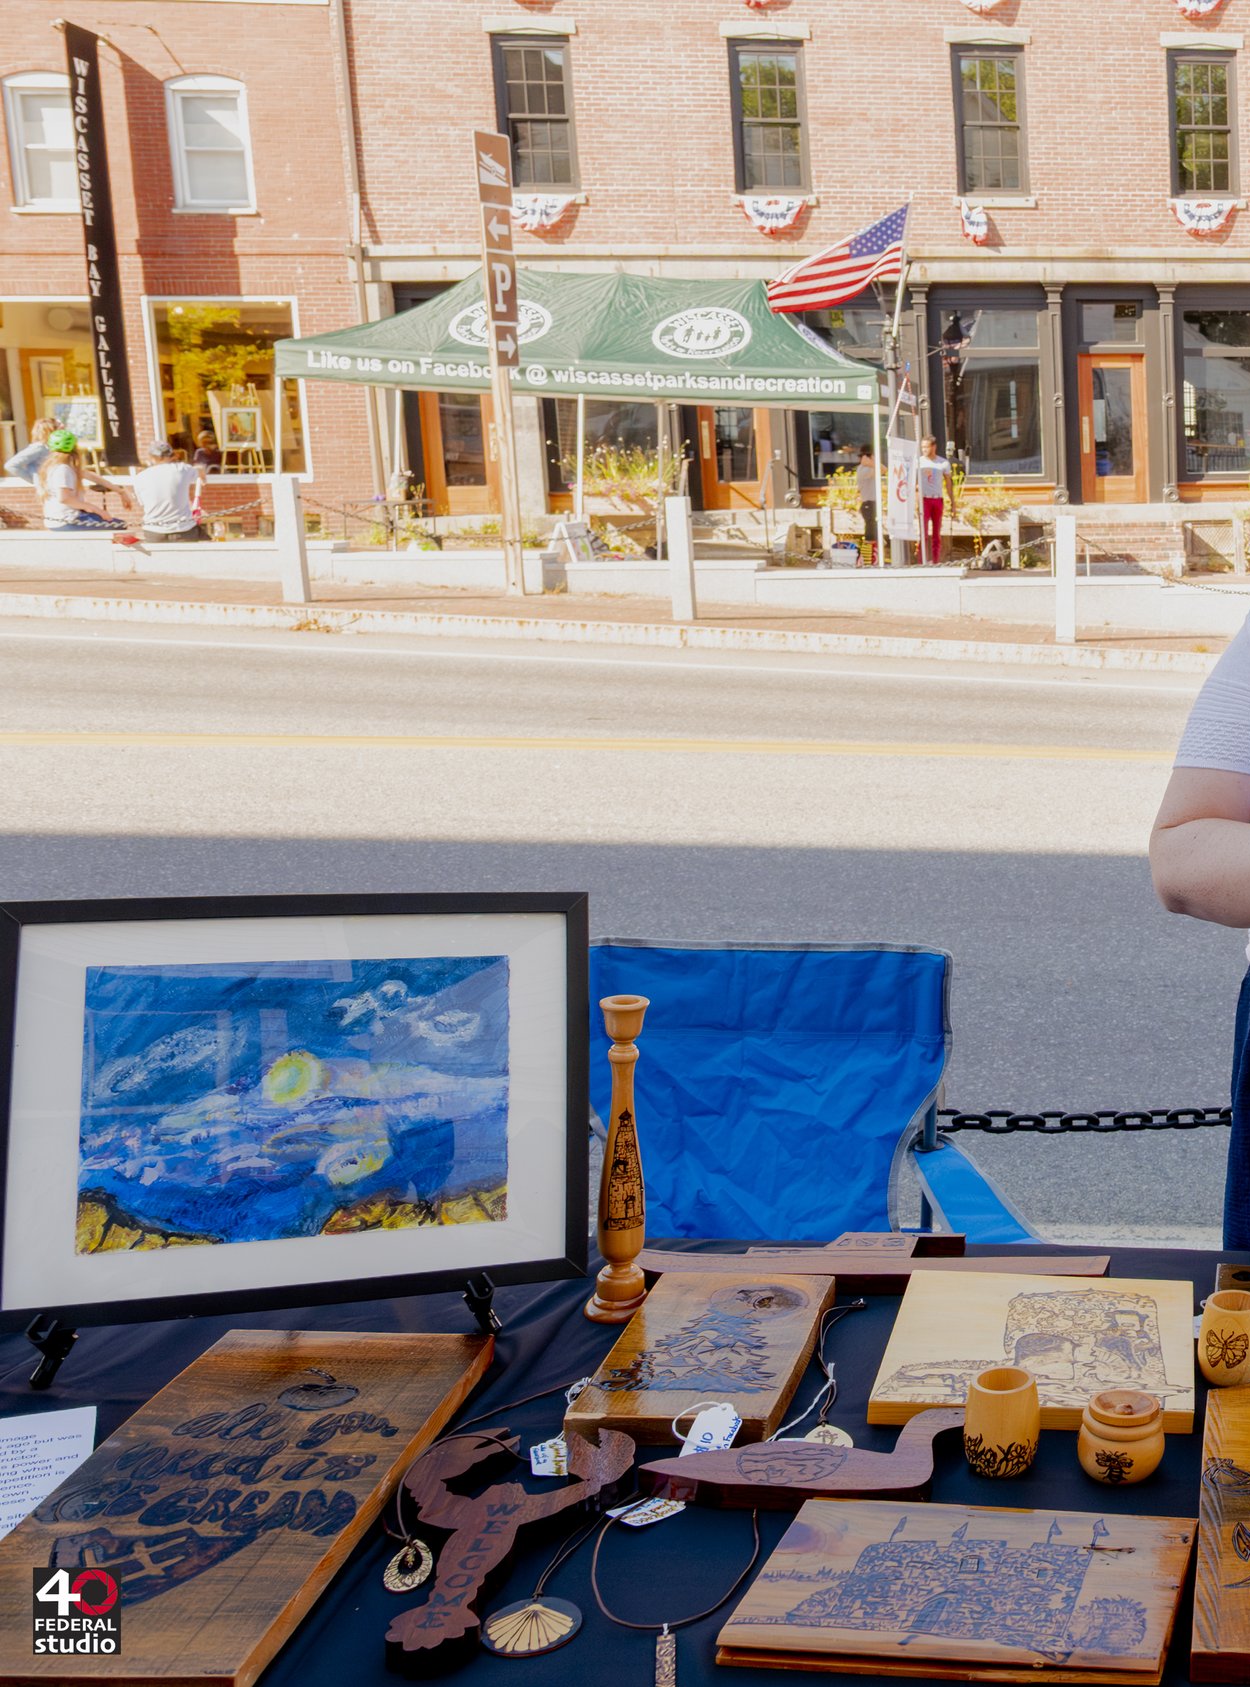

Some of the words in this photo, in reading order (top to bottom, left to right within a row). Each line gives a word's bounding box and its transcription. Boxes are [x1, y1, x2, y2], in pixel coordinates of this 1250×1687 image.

[72, 56, 95, 226] WISCASSET
[87, 243, 102, 297] BAY
[491, 262, 512, 312] P
[94, 315, 120, 437] GALLERY
[307, 349, 351, 370] Like
[357, 357, 383, 372] us
[388, 359, 415, 374] on
[526, 363, 548, 386] @
[551, 366, 846, 394] wiscassetparksandrecreation
[12, 1459, 52, 1470] power
[55, 1453, 79, 1461] and
[137, 1486, 357, 1537] CREAM
[417, 1502, 522, 1630] WELCOME
